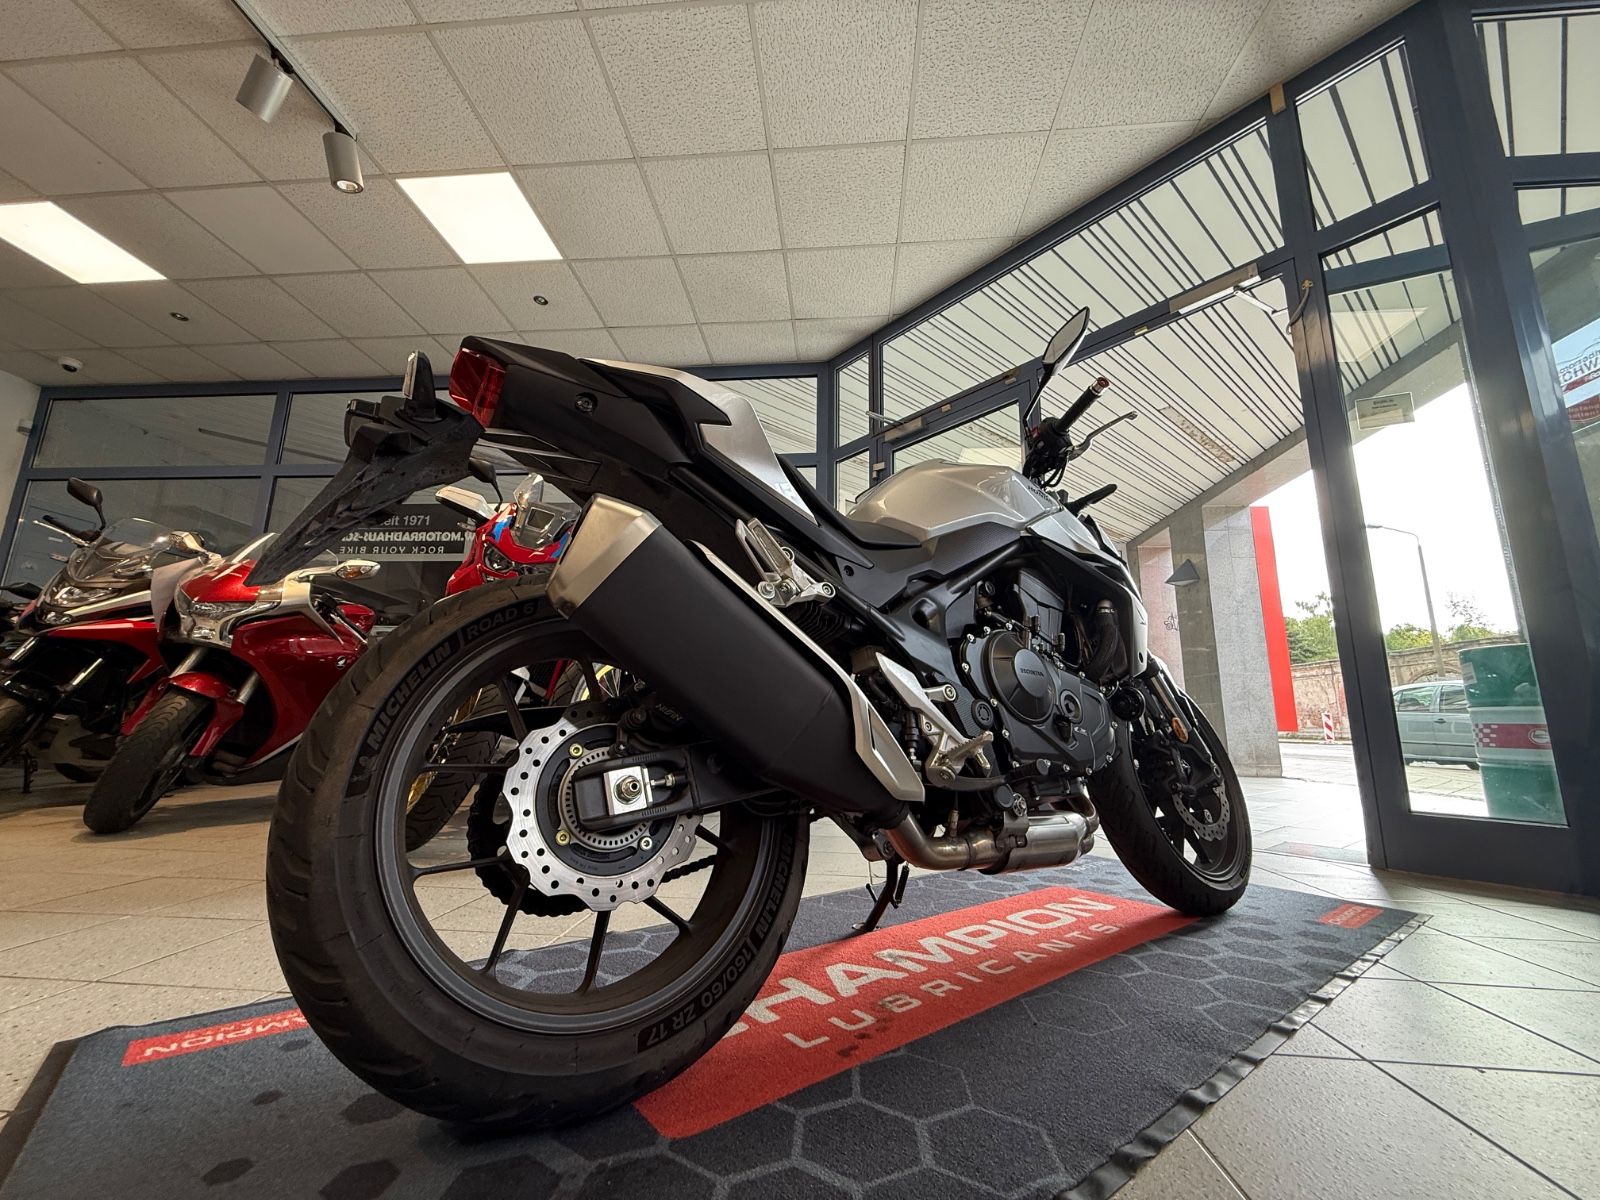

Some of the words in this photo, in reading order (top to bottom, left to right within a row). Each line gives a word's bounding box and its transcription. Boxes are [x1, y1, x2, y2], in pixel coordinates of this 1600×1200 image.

[381, 515, 400, 526] eit
[404, 515, 431, 526] 1971
[466, 609, 519, 639] ROAD
[366, 647, 450, 752] MICHELIN
[755, 832, 794, 939] MICHELIN
[701, 943, 755, 1009] 160/60
[783, 922, 1112, 1049] LUBRICANTS
[649, 1022, 669, 1046] 17
[672, 1006, 698, 1028] ZR
